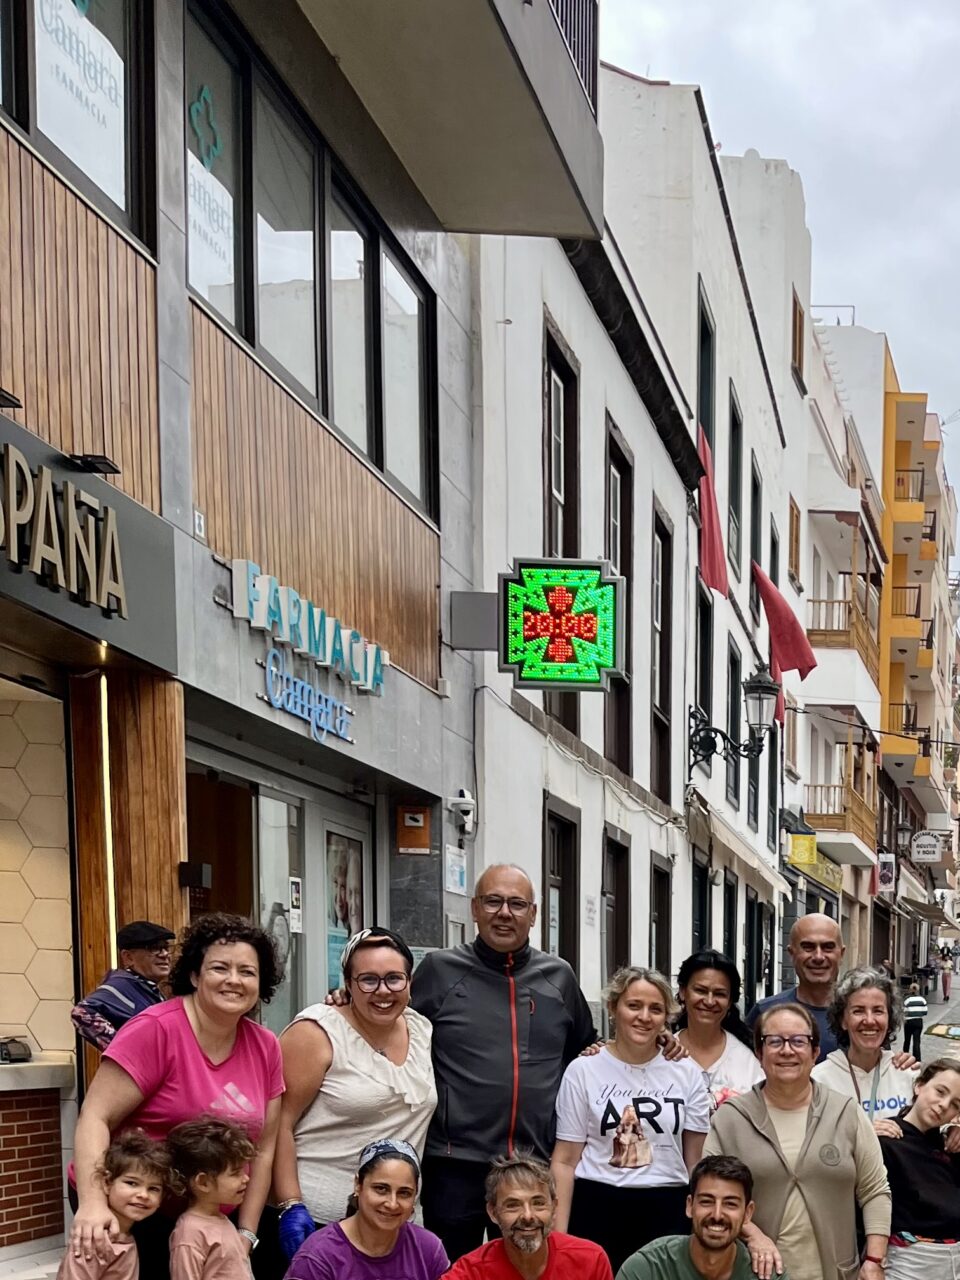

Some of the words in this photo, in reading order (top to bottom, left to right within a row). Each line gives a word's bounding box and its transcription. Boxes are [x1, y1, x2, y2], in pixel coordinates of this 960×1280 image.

[54, 65, 108, 128] FARMACIA
[190, 218, 227, 263] ARMACIA
[0, 443, 129, 620] PAÑA
[233, 559, 386, 697] FARMACIA
[596, 1083, 632, 1105] You
[637, 1083, 674, 1098] need
[601, 1097, 685, 1137] ART
